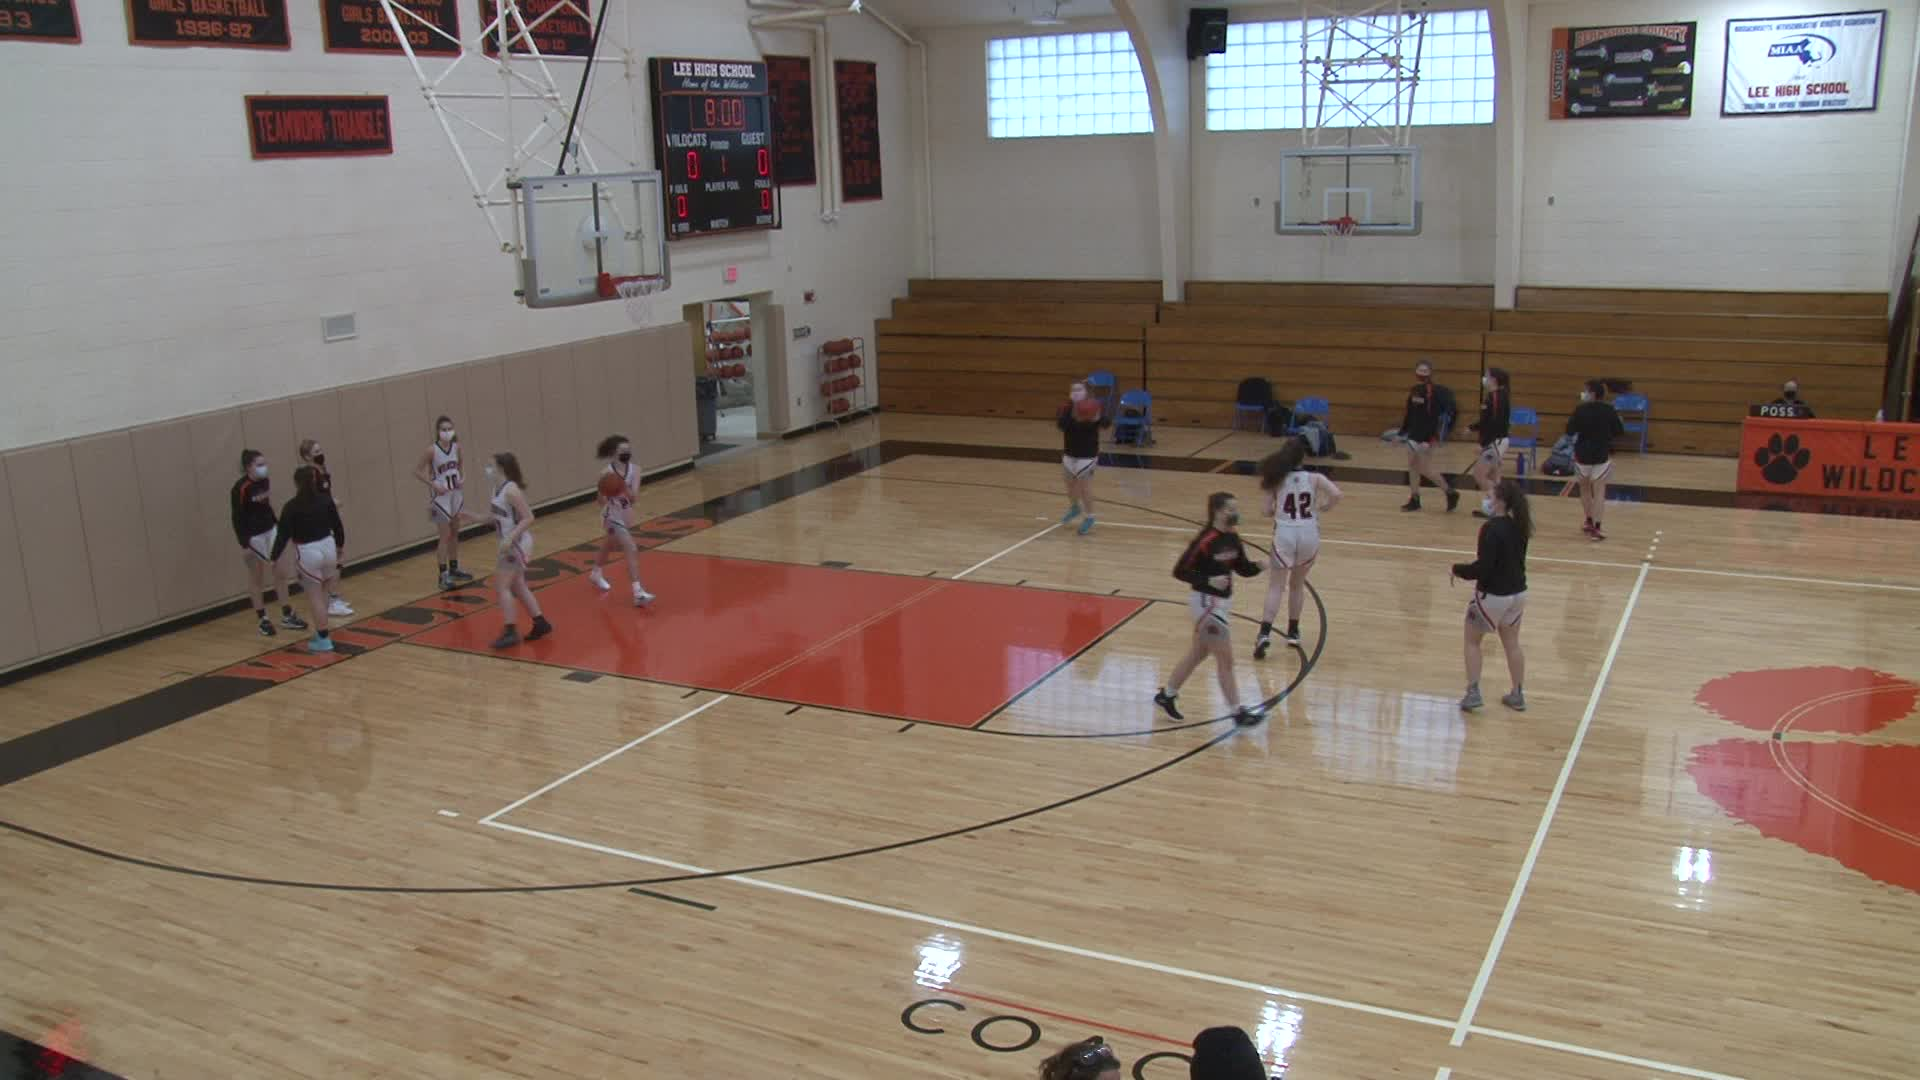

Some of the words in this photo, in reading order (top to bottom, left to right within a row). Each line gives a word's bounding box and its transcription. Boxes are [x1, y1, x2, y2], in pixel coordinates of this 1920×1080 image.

[673, 61, 692, 77] LEE
[694, 62, 718, 78] HIGH
[719, 63, 756, 79] SCHOOL
[1748, 86, 1770, 99] LEE
[1775, 84, 1801, 98] HIGH
[1806, 82, 1849, 96] SCHOOL
[741, 131, 765, 146] GUEST
[1760, 405, 1795, 417] POSS
[1283, 492, 1313, 520] 42
